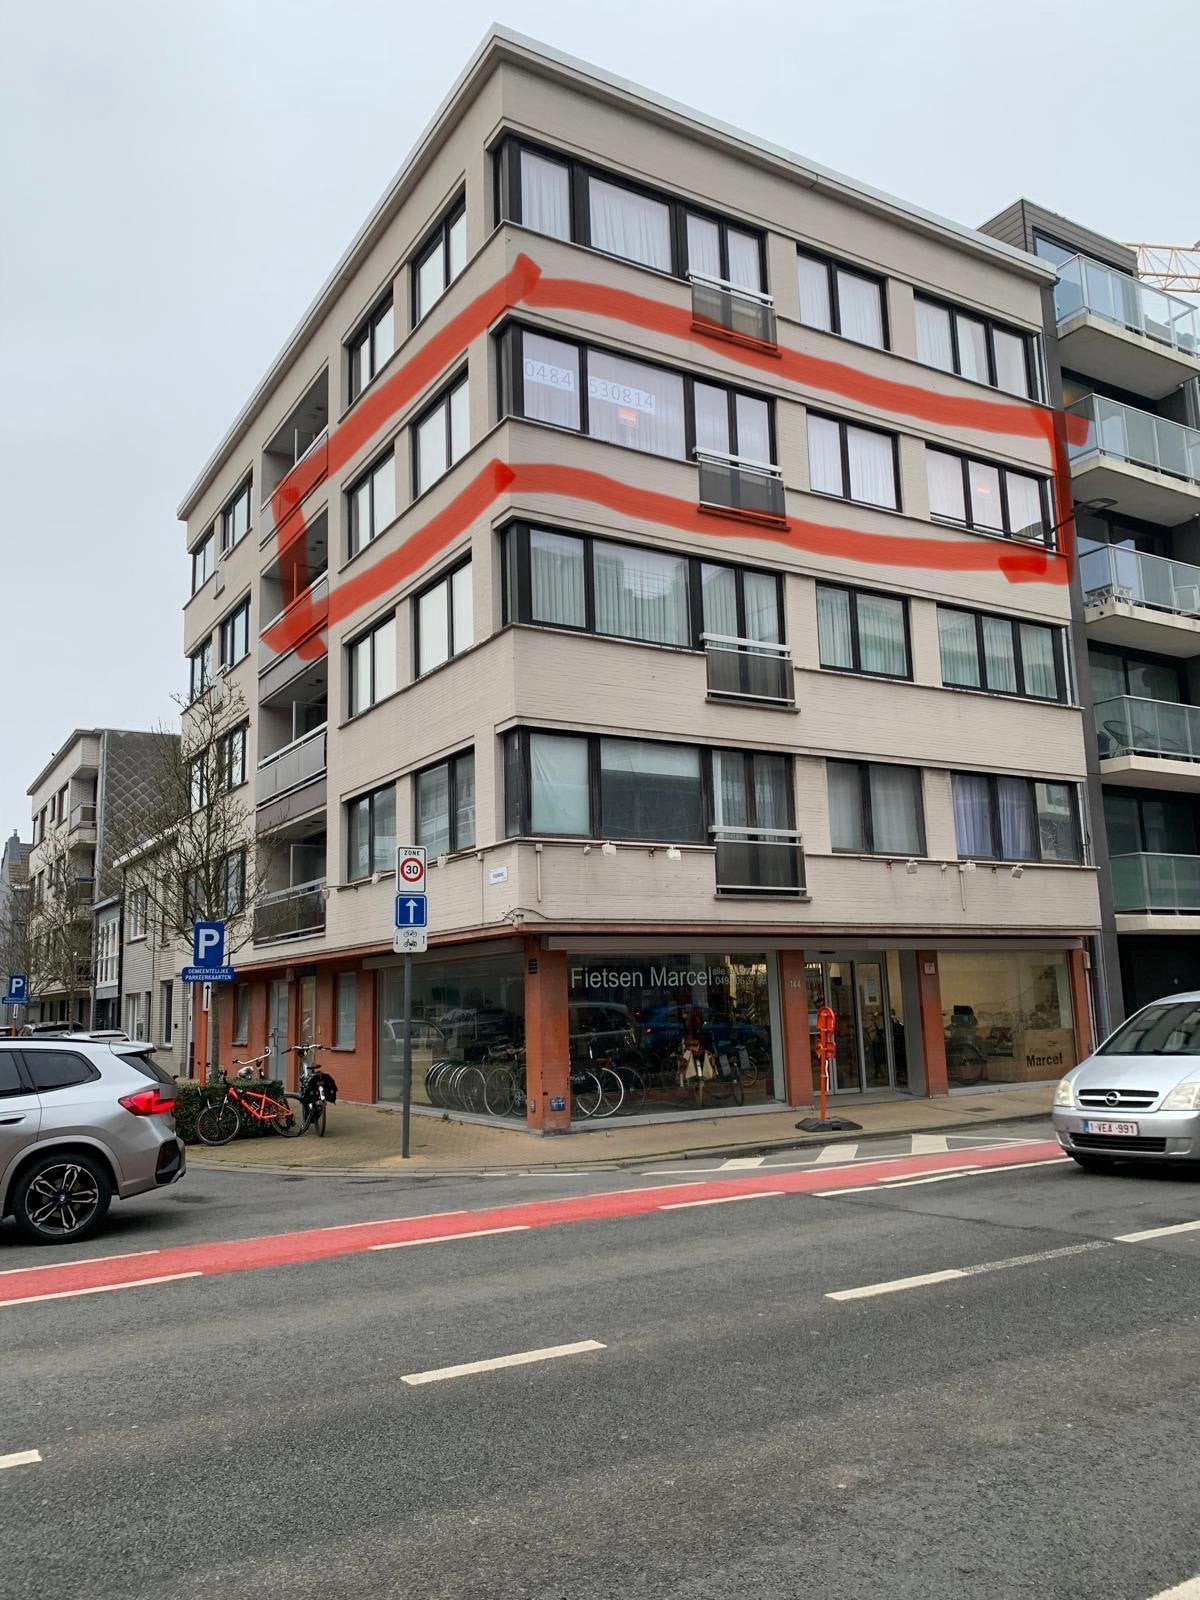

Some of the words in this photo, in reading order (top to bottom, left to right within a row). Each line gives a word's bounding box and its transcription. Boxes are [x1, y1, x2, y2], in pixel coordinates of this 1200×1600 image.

[524, 360, 572, 387] 0484
[589, 379, 655, 407] 530814
[405, 865, 419, 875] 30
[198, 928, 220, 959] P
[11, 978, 24, 994] P
[571, 967, 643, 989] Fietsen
[650, 966, 712, 987] Marcel
[1026, 1052, 1063, 1067] Marcel
